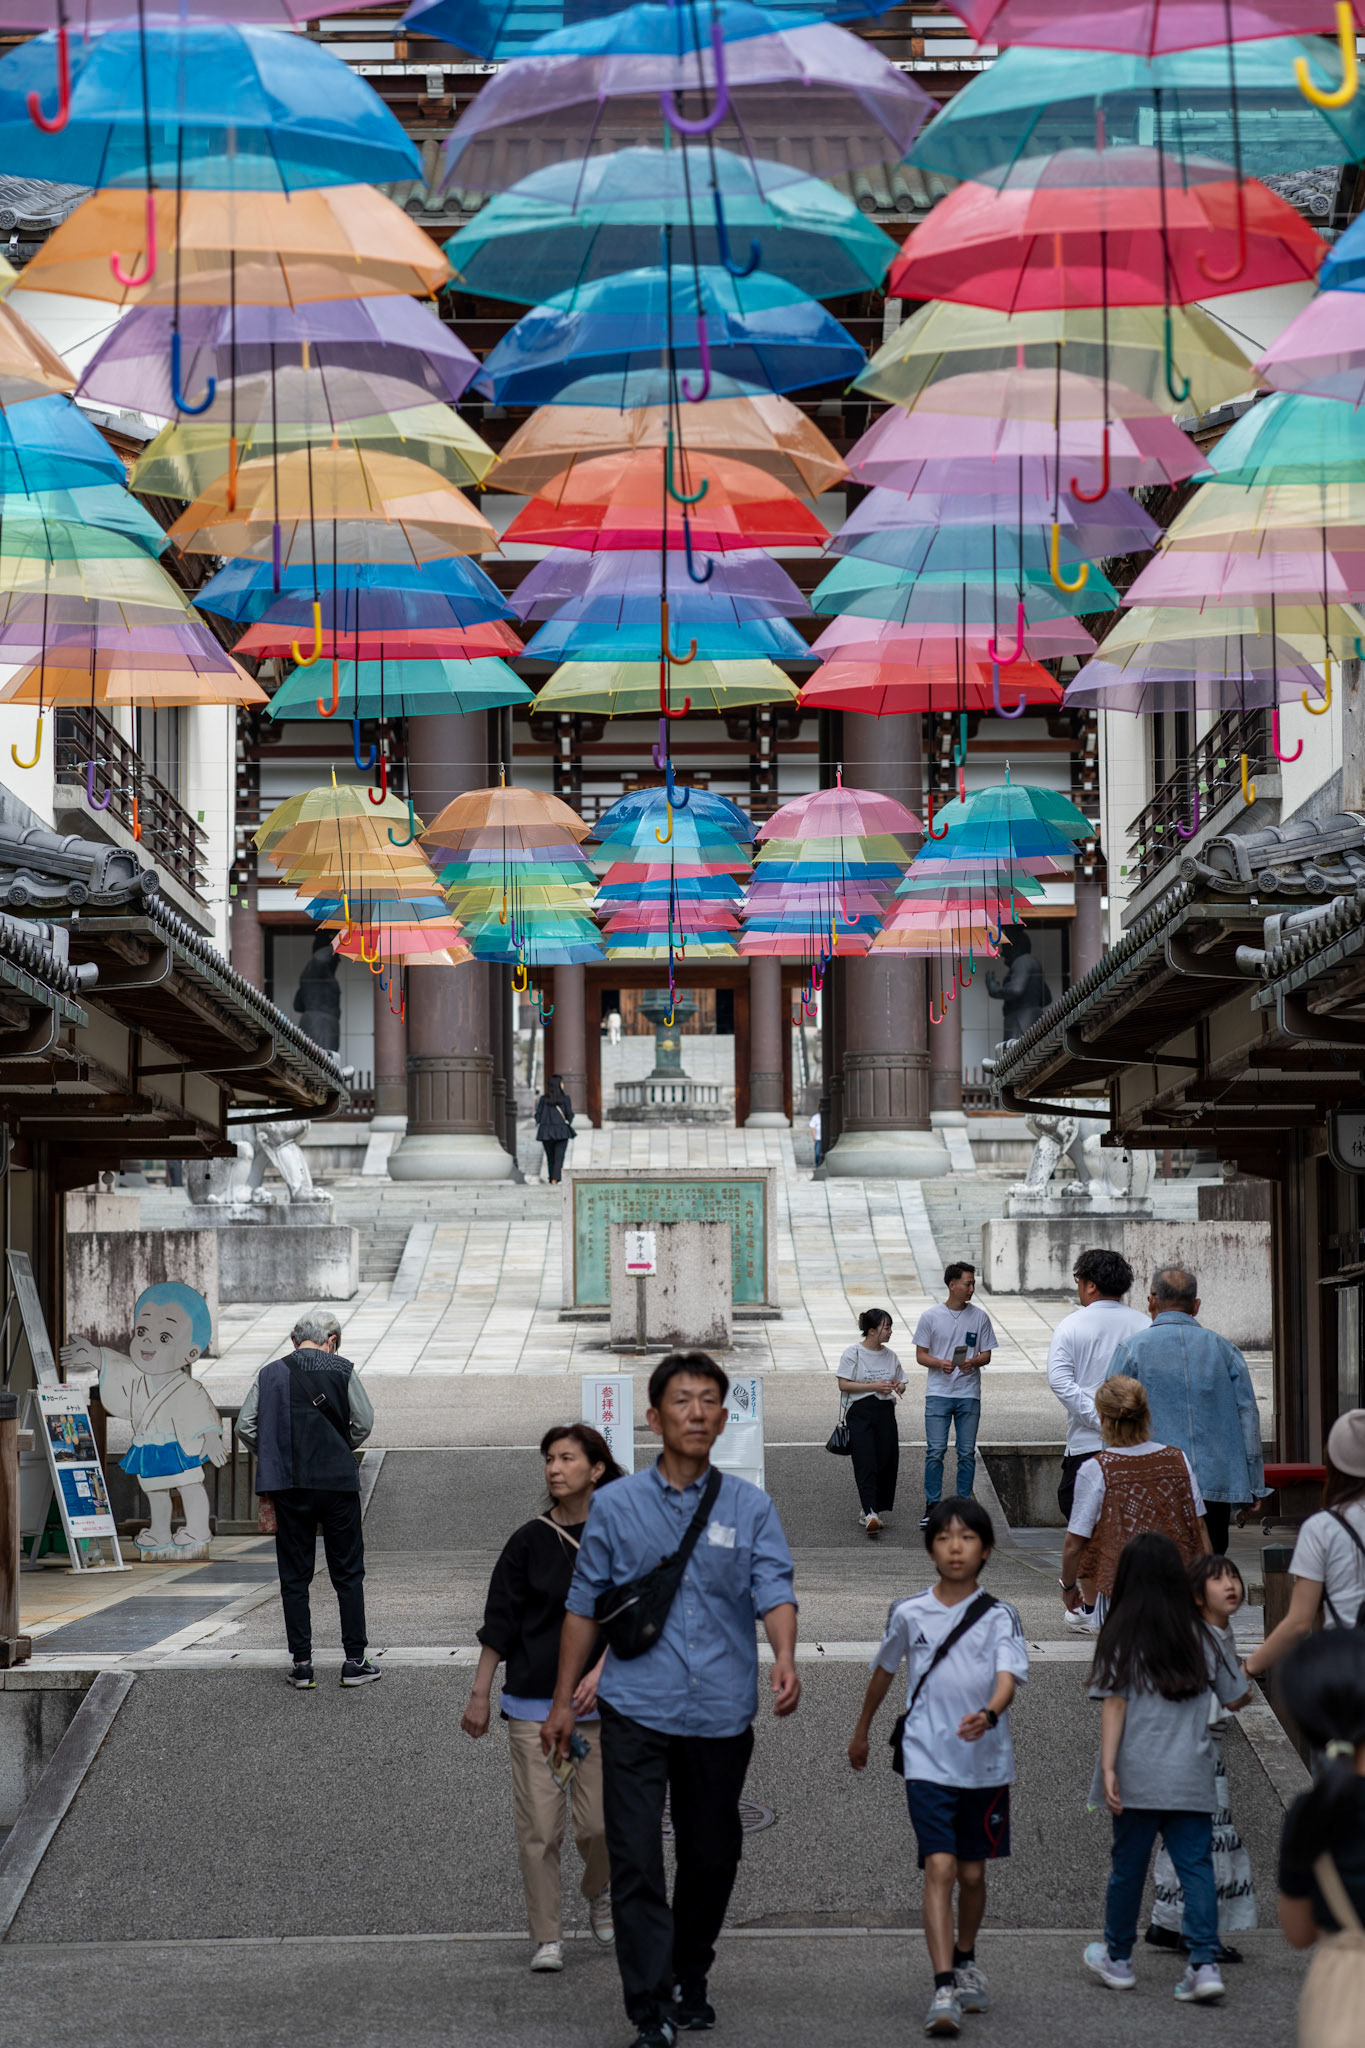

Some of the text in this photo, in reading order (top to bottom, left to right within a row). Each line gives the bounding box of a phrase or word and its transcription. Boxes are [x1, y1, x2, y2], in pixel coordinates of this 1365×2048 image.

[636, 1235, 645, 1260] 御手洗
[601, 1386, 614, 1422] 参拝券
